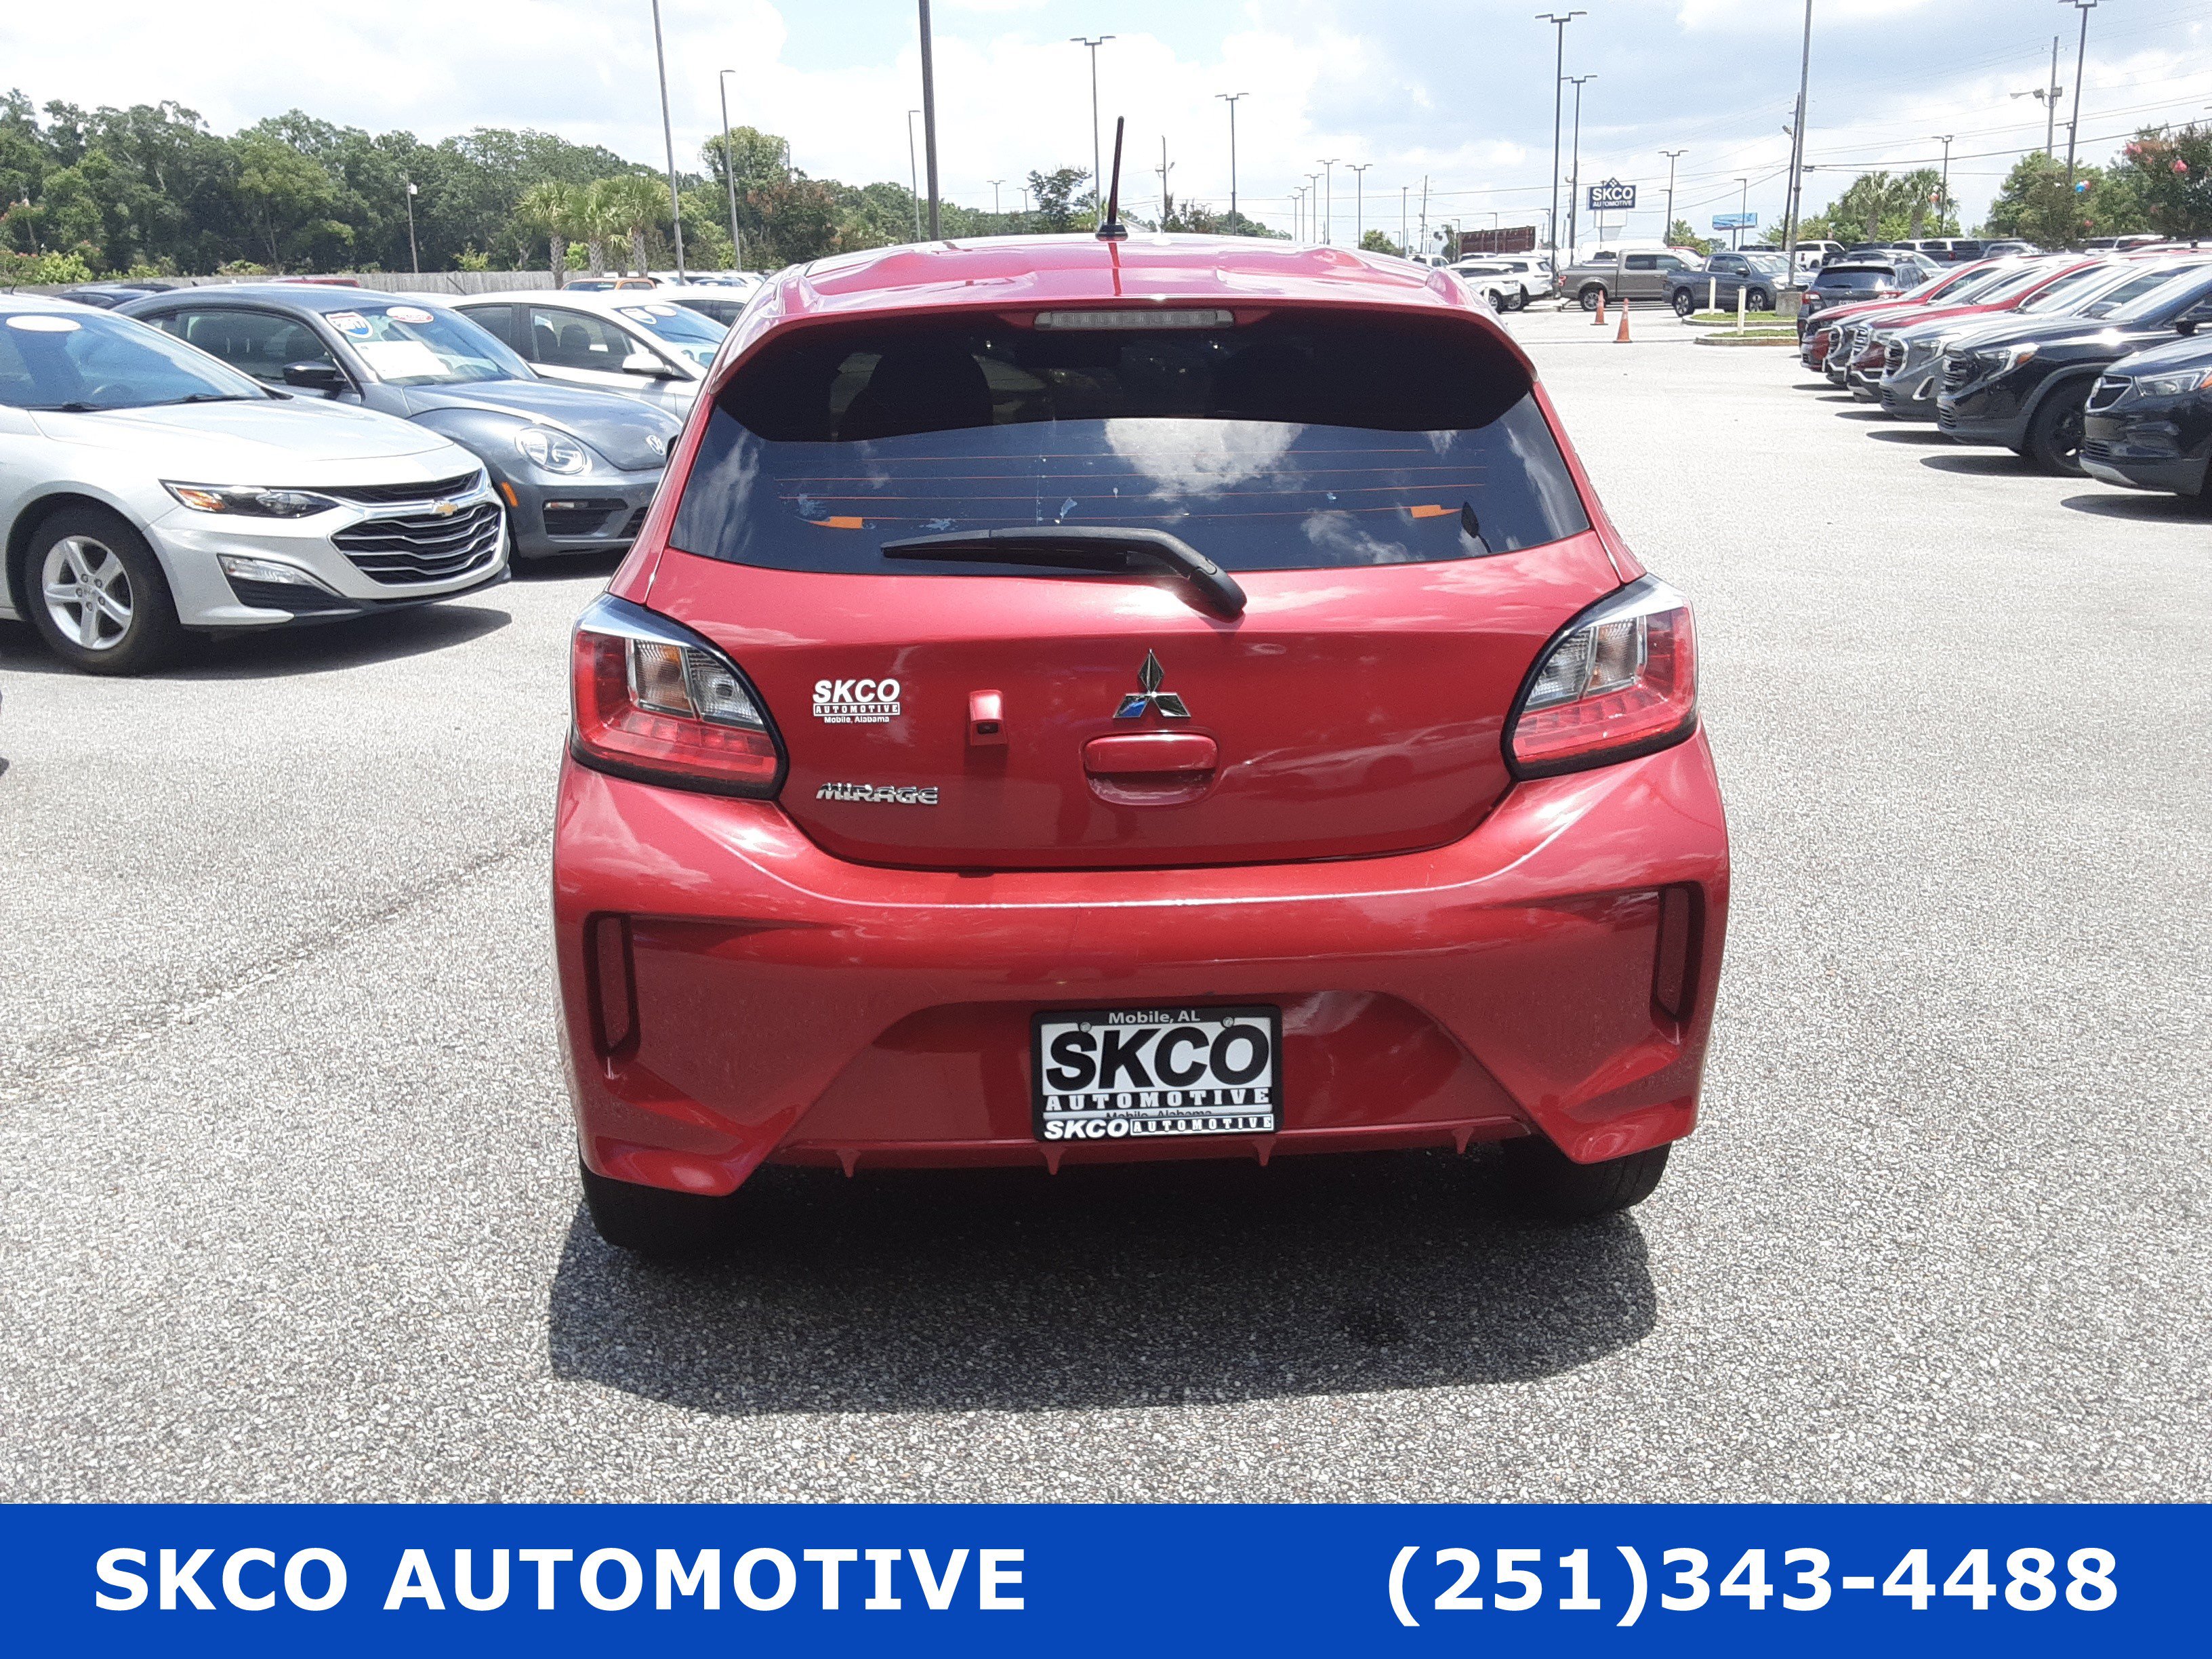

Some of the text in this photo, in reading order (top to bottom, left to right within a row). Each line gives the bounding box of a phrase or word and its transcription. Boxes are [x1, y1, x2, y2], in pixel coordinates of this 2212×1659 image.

[1592, 187, 1633, 201] SKCO
[1593, 199, 1633, 207] AUTOMOTIVE
[813, 678, 900, 703] SKCO
[815, 704, 899, 714] AUTOMOTIVE
[823, 716, 853, 724] Mobile,
[816, 782, 939, 805] MIRAGE
[1109, 1009, 1200, 1024] Mobile, AL
[1046, 1024, 1269, 1091] SKCO
[1046, 1088, 1269, 1111] AUTOMOTIVE
[1044, 1116, 1271, 1140] SKCO AUTOMOTIVE
